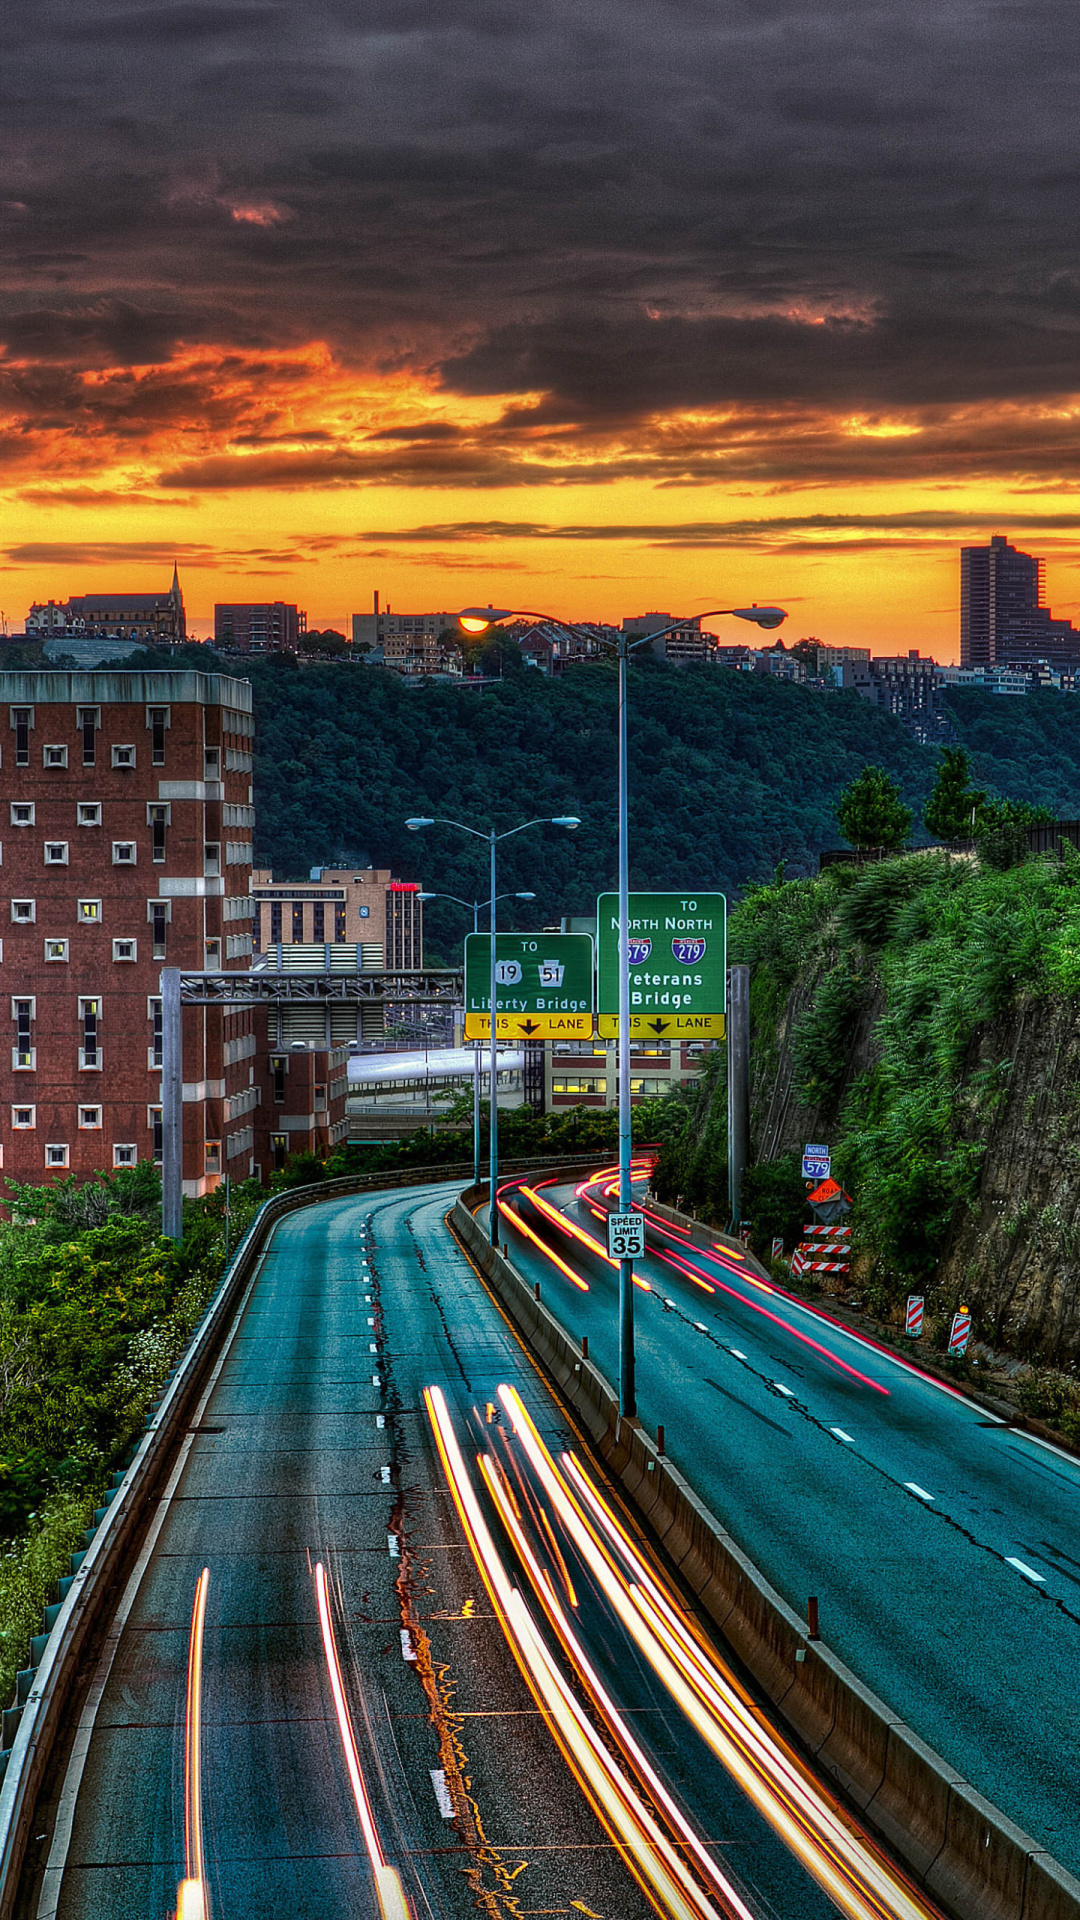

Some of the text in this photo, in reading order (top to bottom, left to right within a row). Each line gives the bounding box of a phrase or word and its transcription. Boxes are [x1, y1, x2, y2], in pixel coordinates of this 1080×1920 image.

[680, 901, 697, 911] TO
[665, 917, 713, 930] NORTH
[521, 941, 538, 952] TO
[678, 944, 700, 959] 279
[500, 966, 517, 980] 19
[543, 968, 559, 982] 51
[536, 997, 587, 1012] Bridge
[631, 992, 692, 1009] Bridge
[549, 1019, 584, 1029] LANE
[611, 1018, 712, 1028] TIS LANE
[807, 1146, 826, 1155] NORTH
[807, 1162, 829, 1174] 579
[610, 1217, 642, 1226] SPEED
[614, 1227, 638, 1235] LIMIT
[613, 1236, 641, 1254] 35
